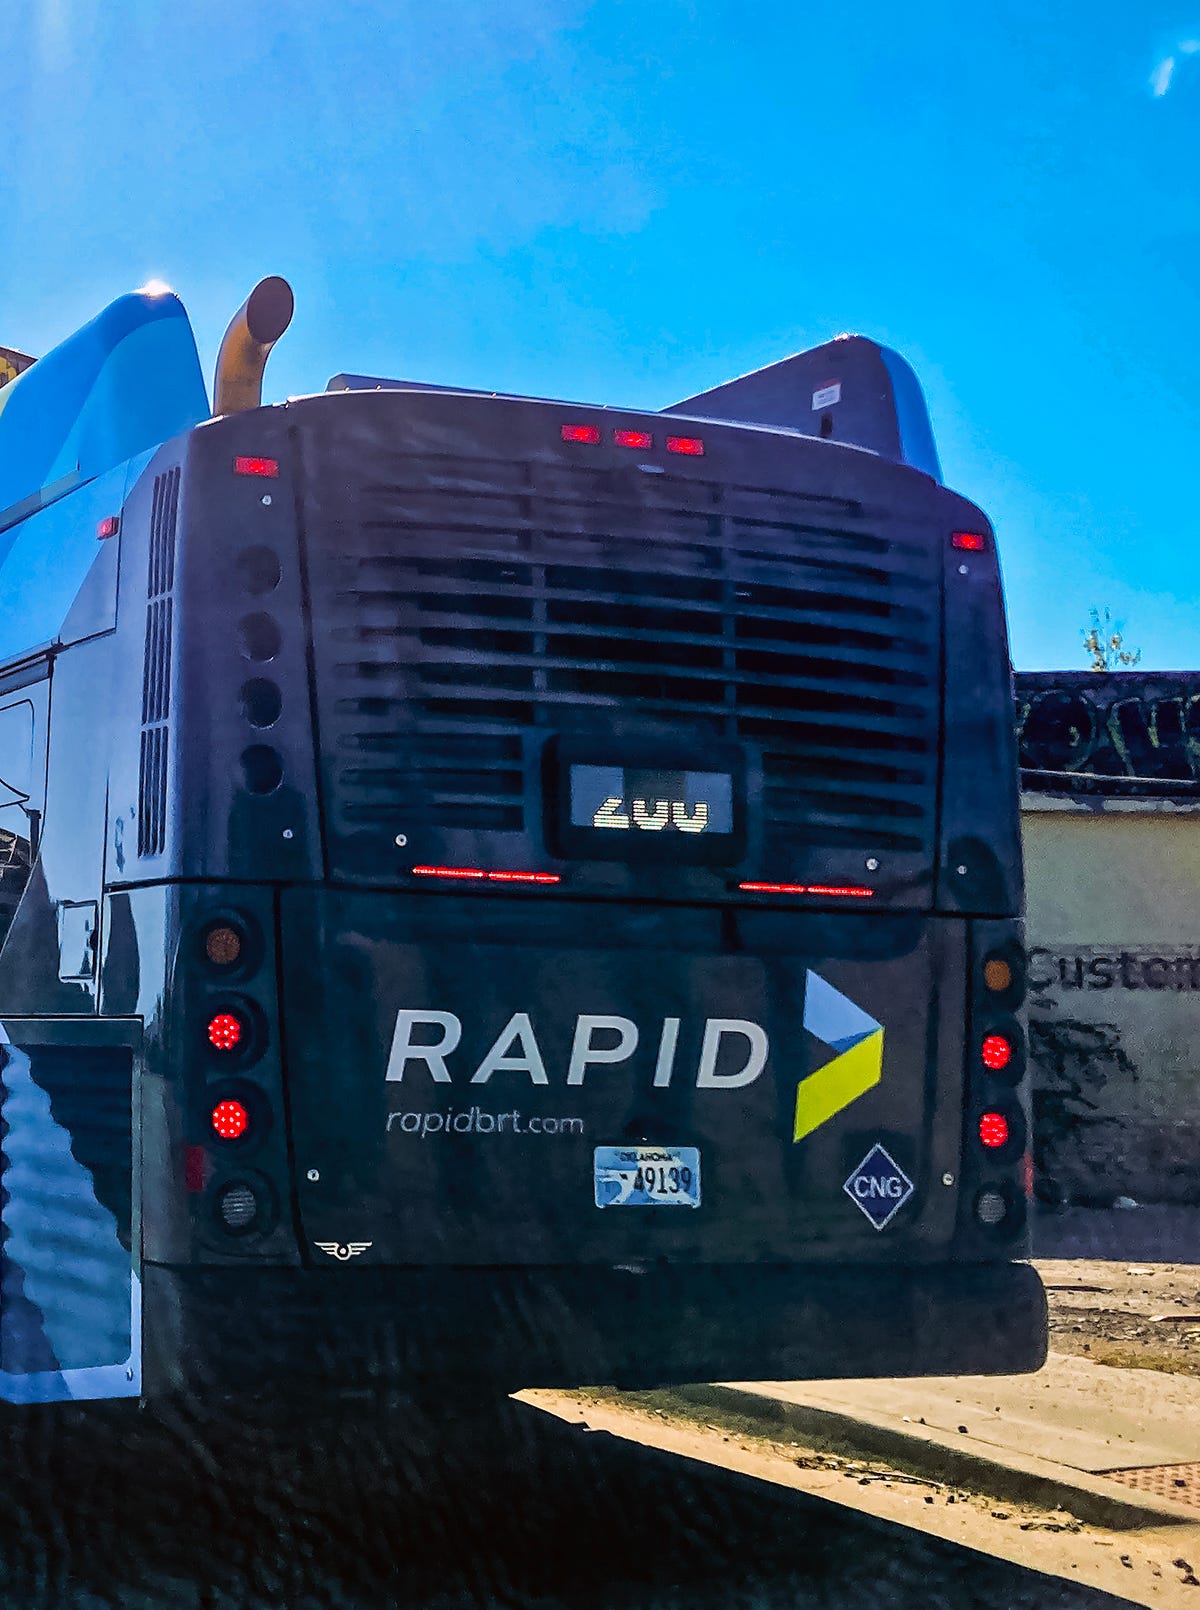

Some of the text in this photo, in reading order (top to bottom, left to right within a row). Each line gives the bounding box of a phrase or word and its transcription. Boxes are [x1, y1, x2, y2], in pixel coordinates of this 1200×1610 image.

[385, 1009, 770, 1089] RAPID
[386, 1106, 584, 1138] rapidbrt.com
[853, 1175, 903, 1198] CNG
